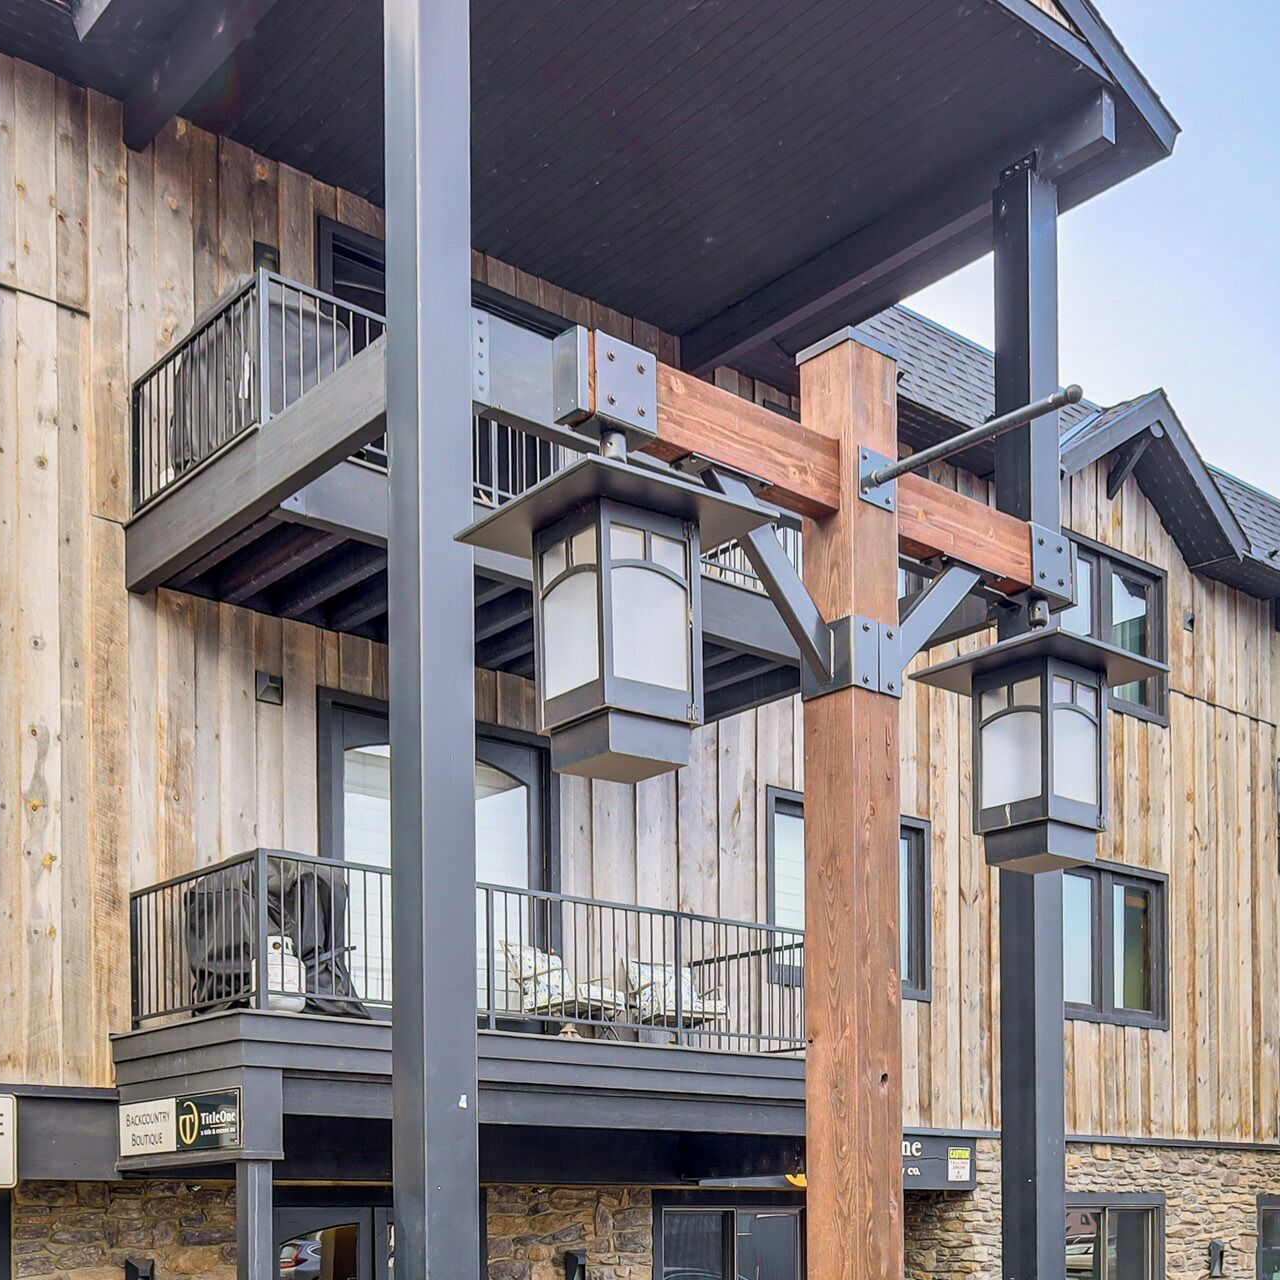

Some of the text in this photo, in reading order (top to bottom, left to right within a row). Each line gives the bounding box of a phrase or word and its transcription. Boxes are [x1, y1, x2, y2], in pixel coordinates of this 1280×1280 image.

[126, 1111, 170, 1127] BACKCOUNTRY
[200, 1110, 236, 1125] TitleOne
[131, 1132, 163, 1147] BOUTIQUE
